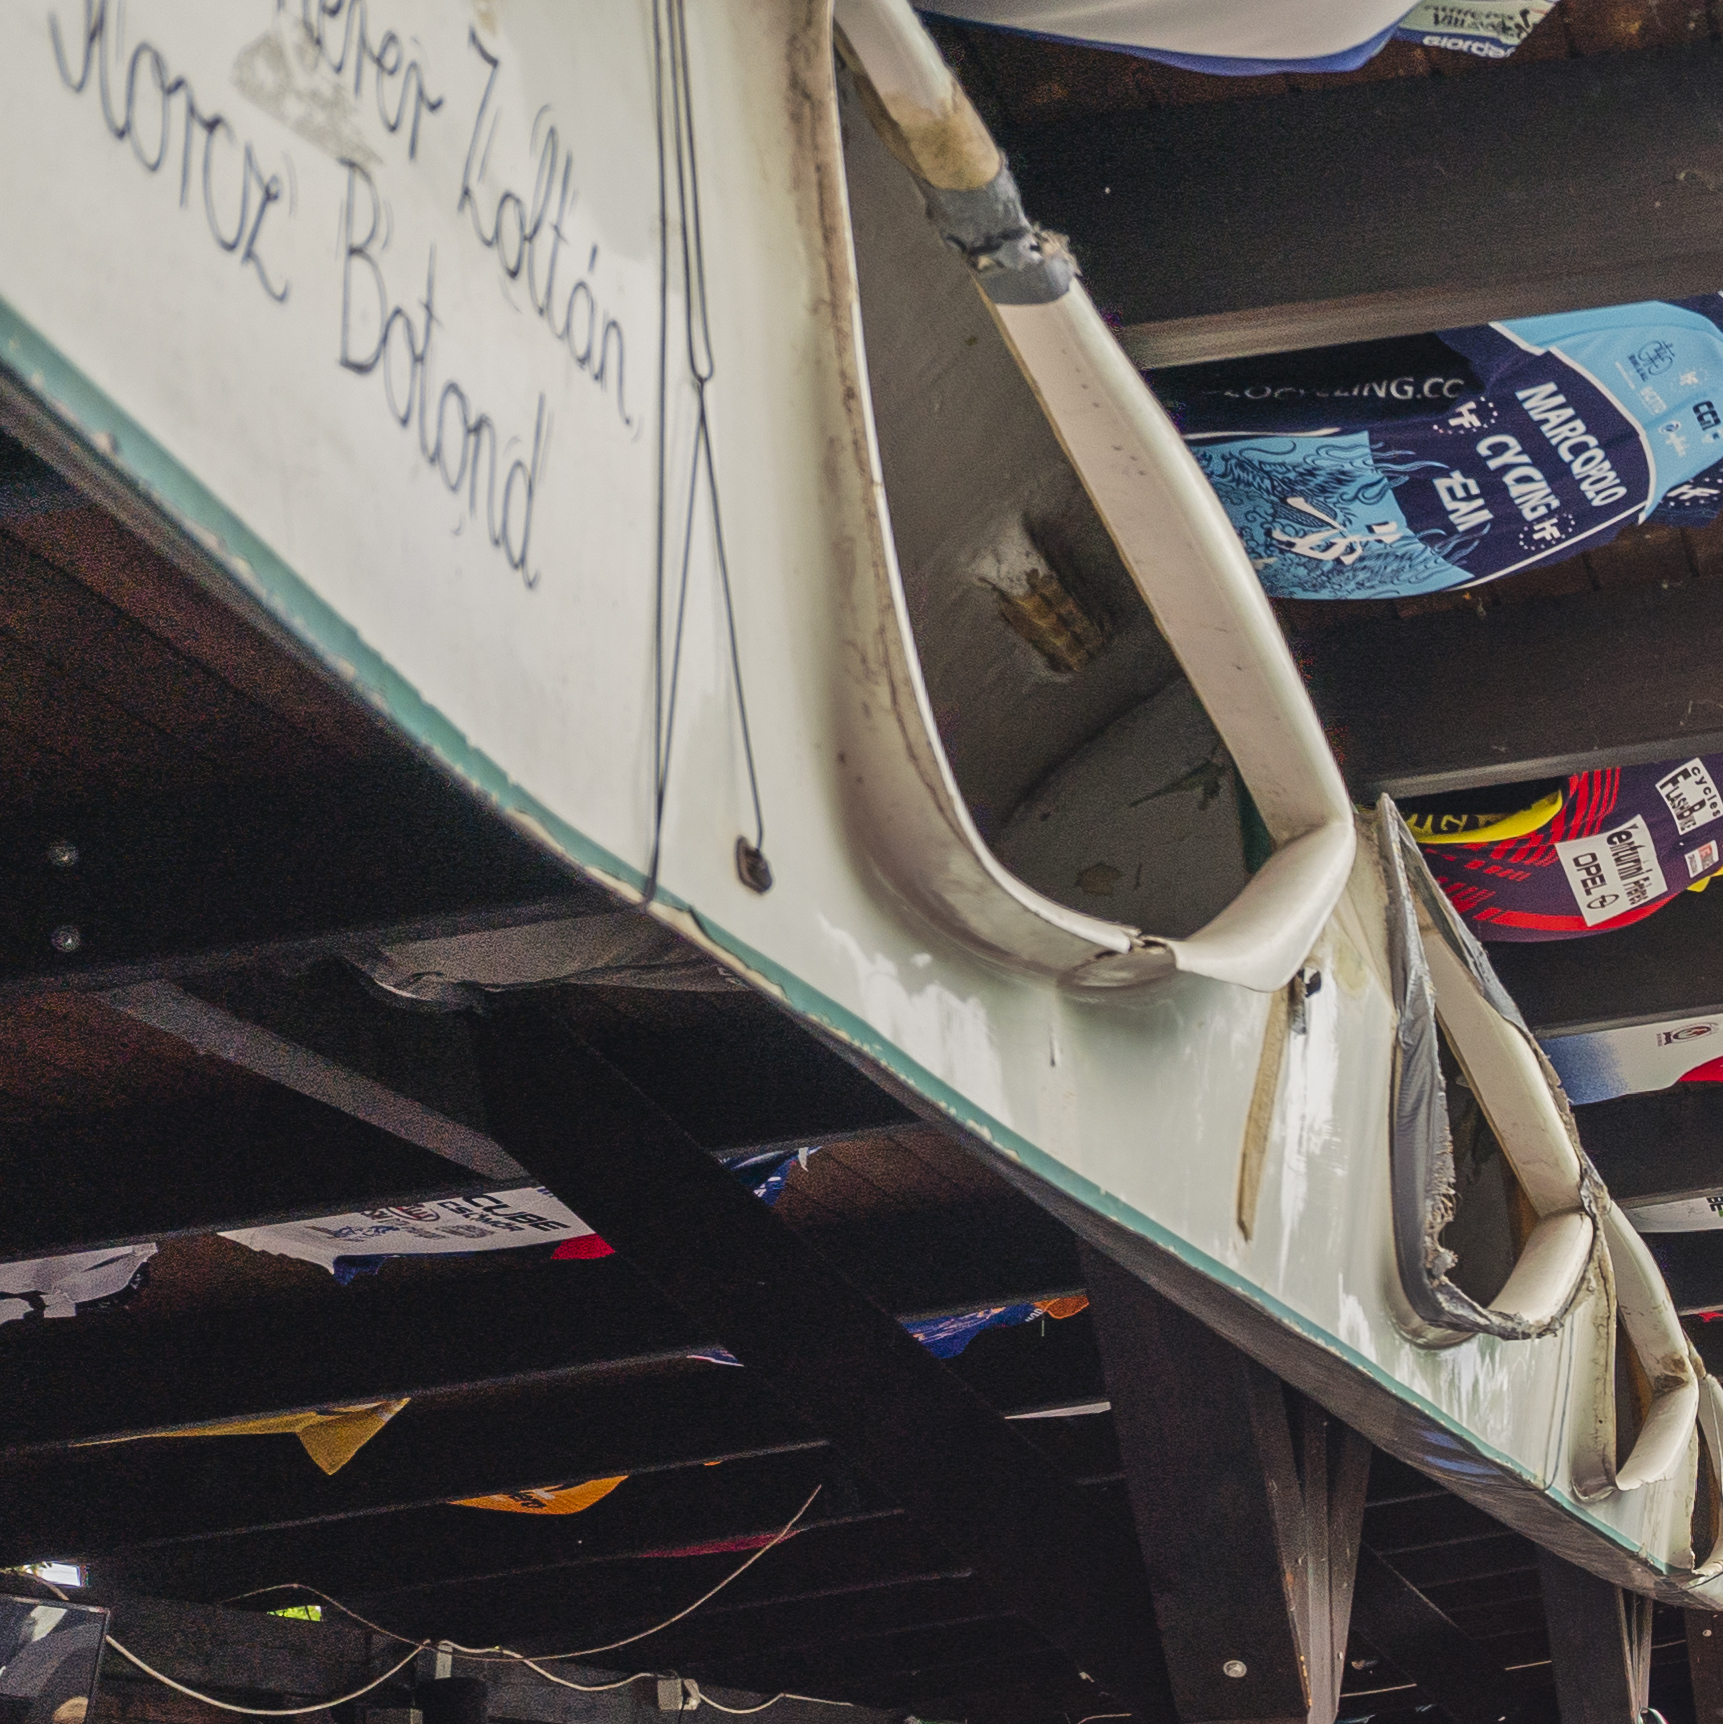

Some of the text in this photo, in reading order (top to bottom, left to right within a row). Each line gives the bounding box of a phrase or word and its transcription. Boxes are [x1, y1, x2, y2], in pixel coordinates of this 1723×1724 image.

[458, 25, 635, 428] Zoltán
[337, 158, 541, 590] Botond
[1515, 382, 1628, 508] MARCOPOLO
[1691, 765, 1722, 818] cycles
[1573, 852, 1605, 897] OPEL
